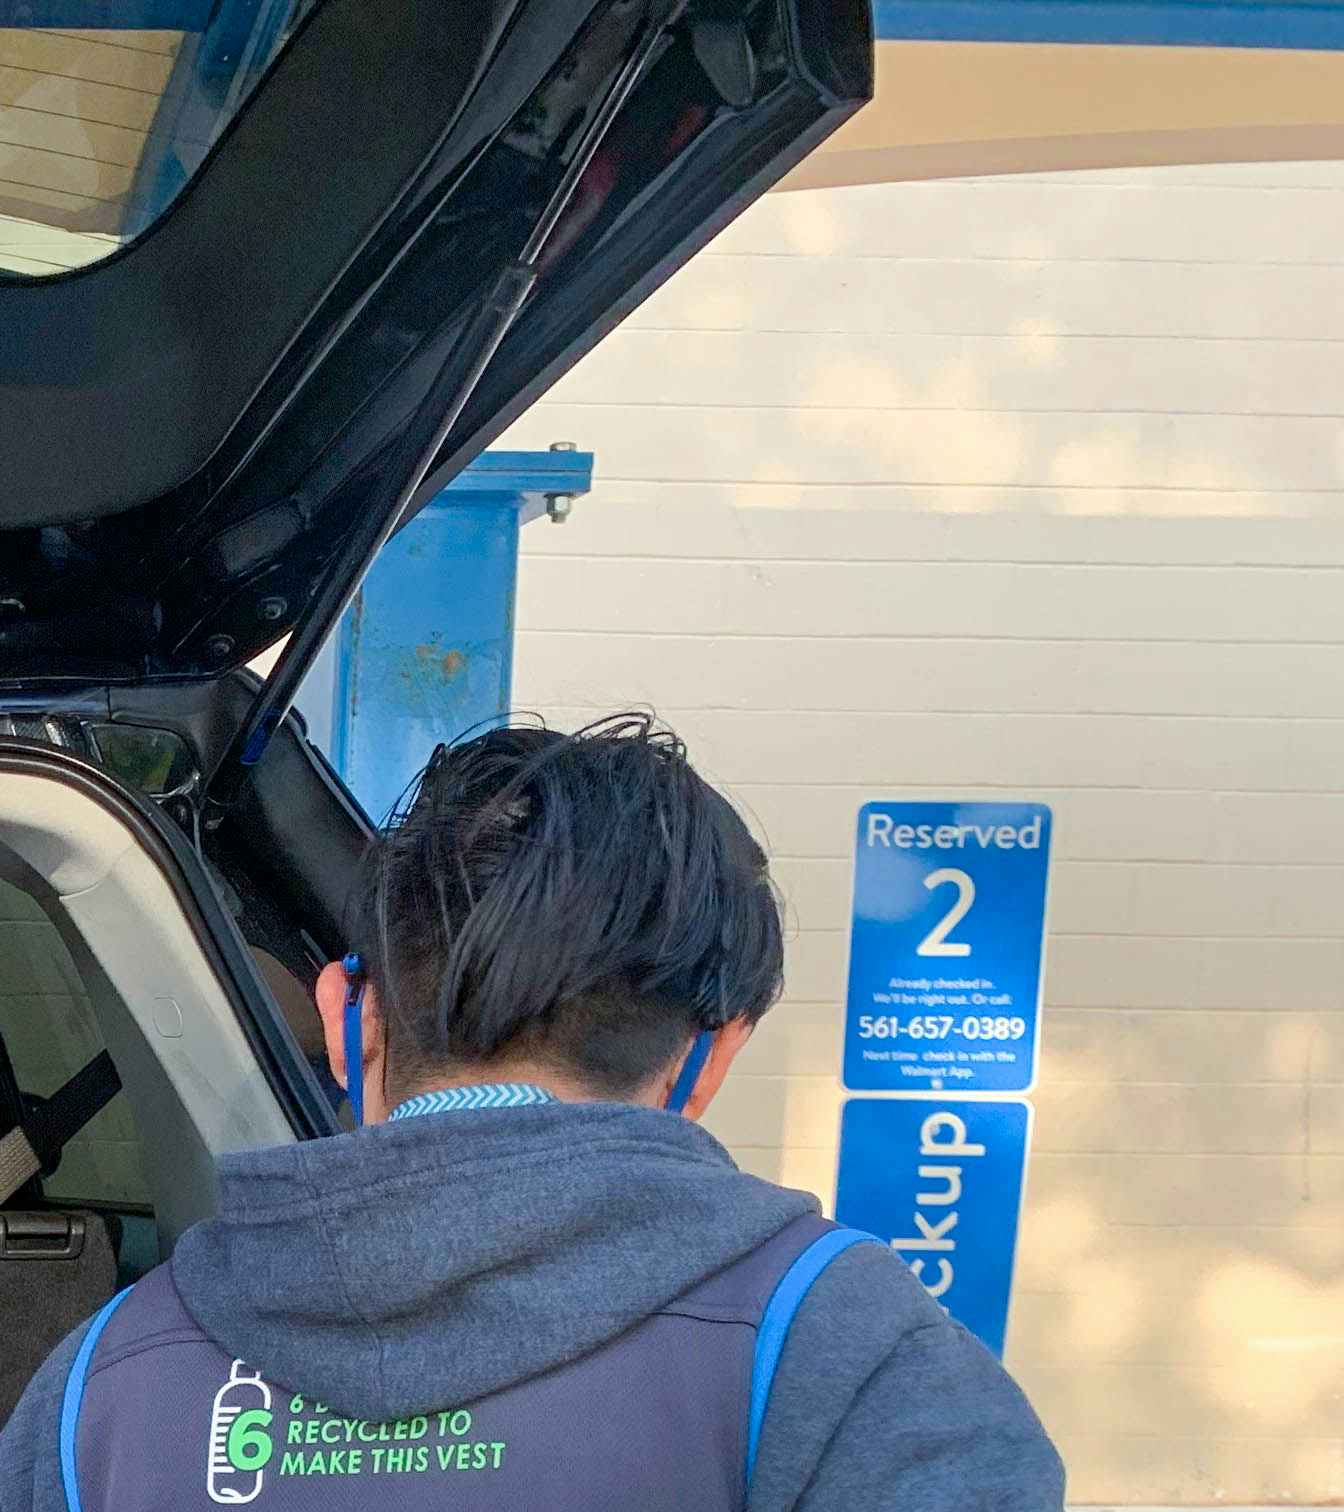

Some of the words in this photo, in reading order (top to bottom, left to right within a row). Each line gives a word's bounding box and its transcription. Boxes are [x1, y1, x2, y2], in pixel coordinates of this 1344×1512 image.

[866, 813, 1042, 849] Reserved
[916, 867, 976, 957] 2
[858, 1015, 1025, 1040] 561-657-0389
[890, 1111, 986, 1316] ckup
[227, 1409, 273, 1471] 6
[287, 1416, 428, 1444] RECYCLED
[437, 1409, 472, 1438] TO
[279, 1449, 363, 1476] MAKE
[370, 1447, 430, 1474] THIS
[436, 1442, 506, 1471] VEST
